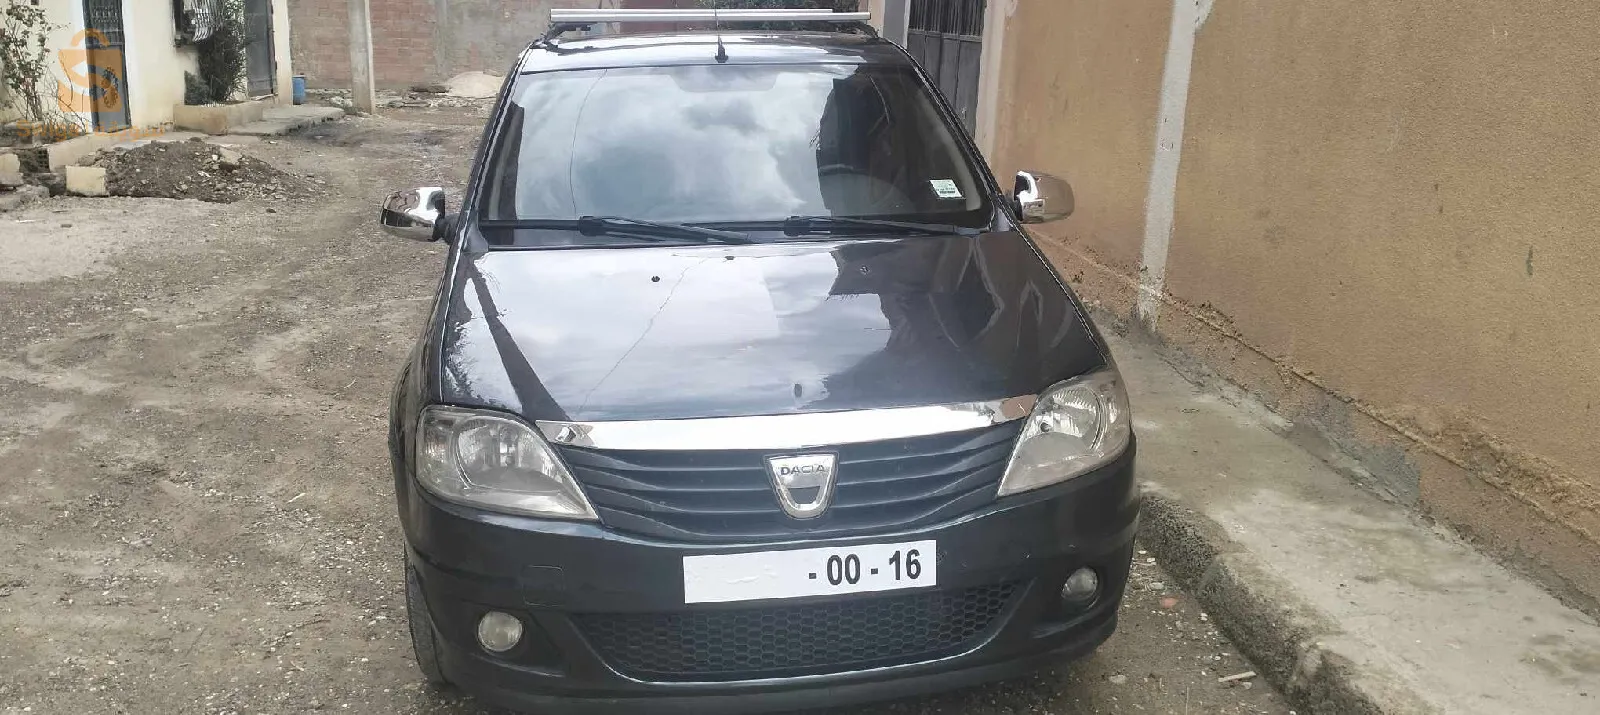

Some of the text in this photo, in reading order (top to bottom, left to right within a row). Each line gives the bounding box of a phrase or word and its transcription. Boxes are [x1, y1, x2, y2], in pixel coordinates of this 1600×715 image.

[780, 464, 825, 476] DACIA
[826, 553, 861, 585] 00
[889, 549, 922, 580] 16
